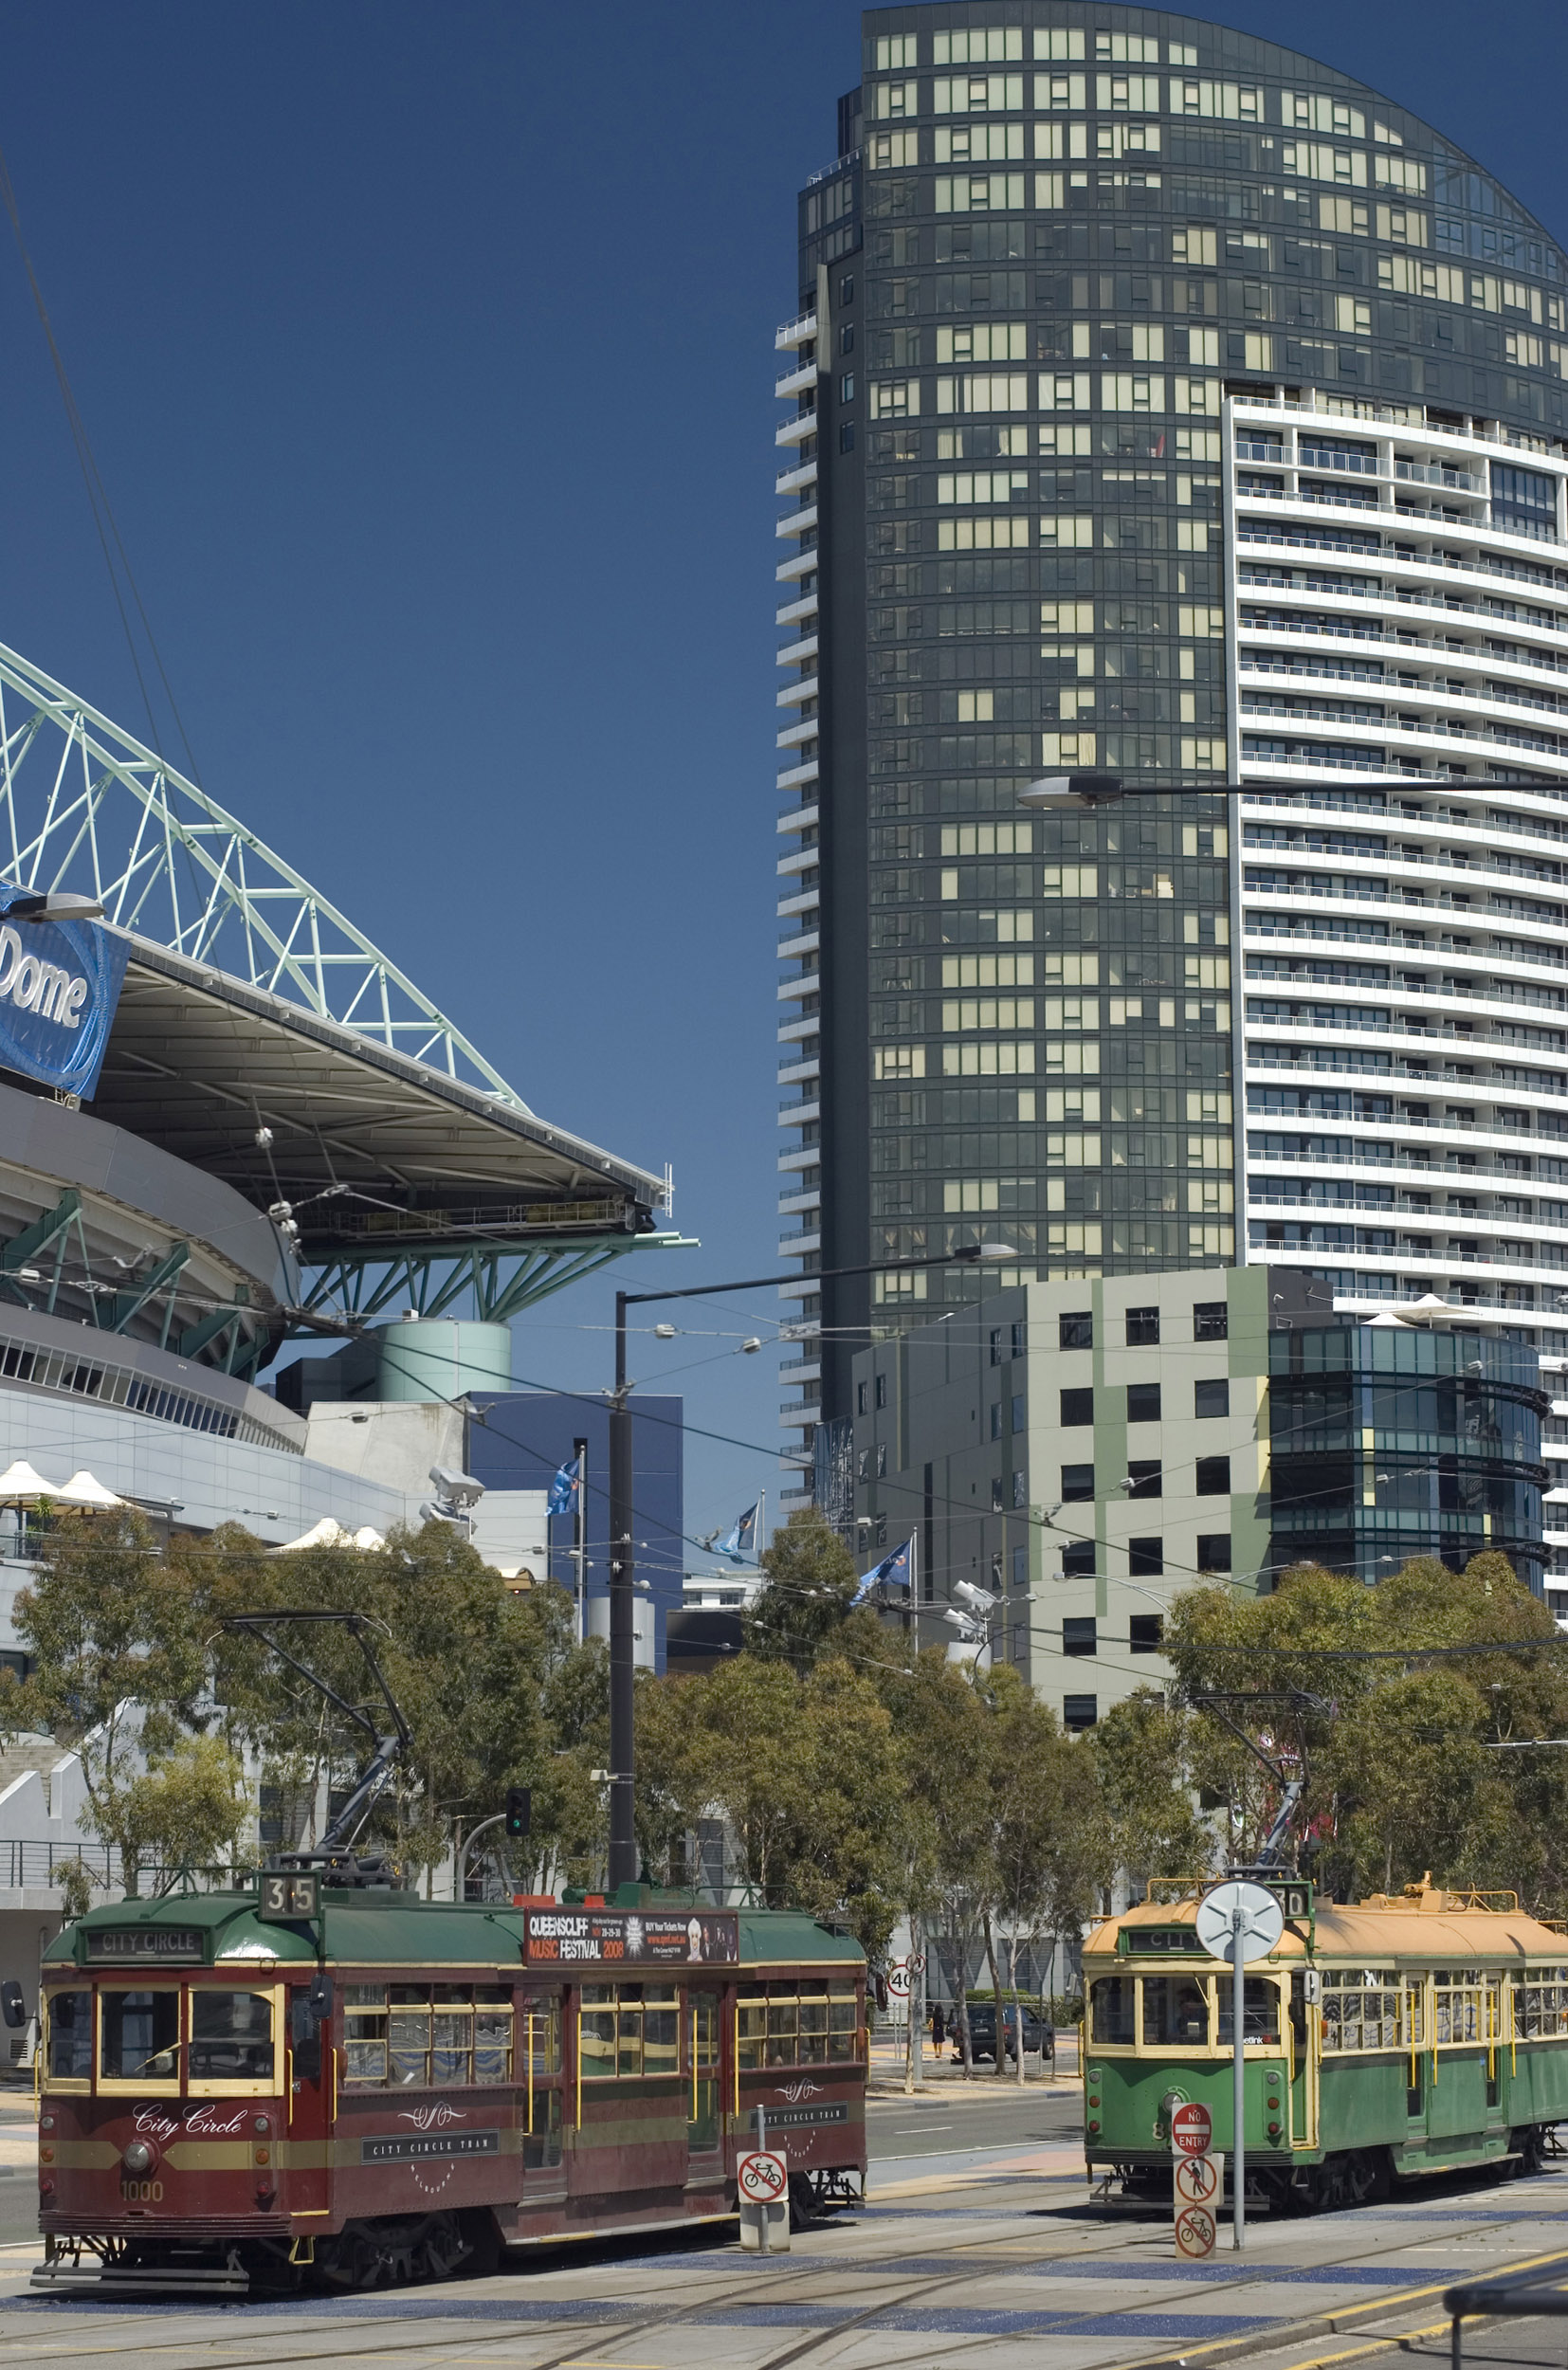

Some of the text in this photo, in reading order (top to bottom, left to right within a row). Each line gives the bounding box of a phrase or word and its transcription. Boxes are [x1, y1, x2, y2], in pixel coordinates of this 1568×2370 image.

[0, 925, 88, 1029] Dome
[267, 1878, 315, 1910] 35
[529, 1916, 589, 1936] QUEENSCLIFF
[645, 1922, 654, 1931] BUY
[102, 1933, 194, 1951] CITY CIRCLE
[1150, 1932, 1199, 1946] CITY
[529, 1939, 624, 1960] MUSIC FESTIVAL 2008
[1243, 2035, 1263, 2045] etlink
[133, 2104, 248, 2142] City Circle
[784, 2112, 813, 2123] CIRCLE
[819, 2109, 840, 2119] TRAM
[1188, 2111, 1201, 2123] NO
[373, 2139, 488, 2156] CITY CIRCLE TRAM
[1178, 2136, 1207, 2147] ENTRY
[120, 2180, 163, 2202] 1000
